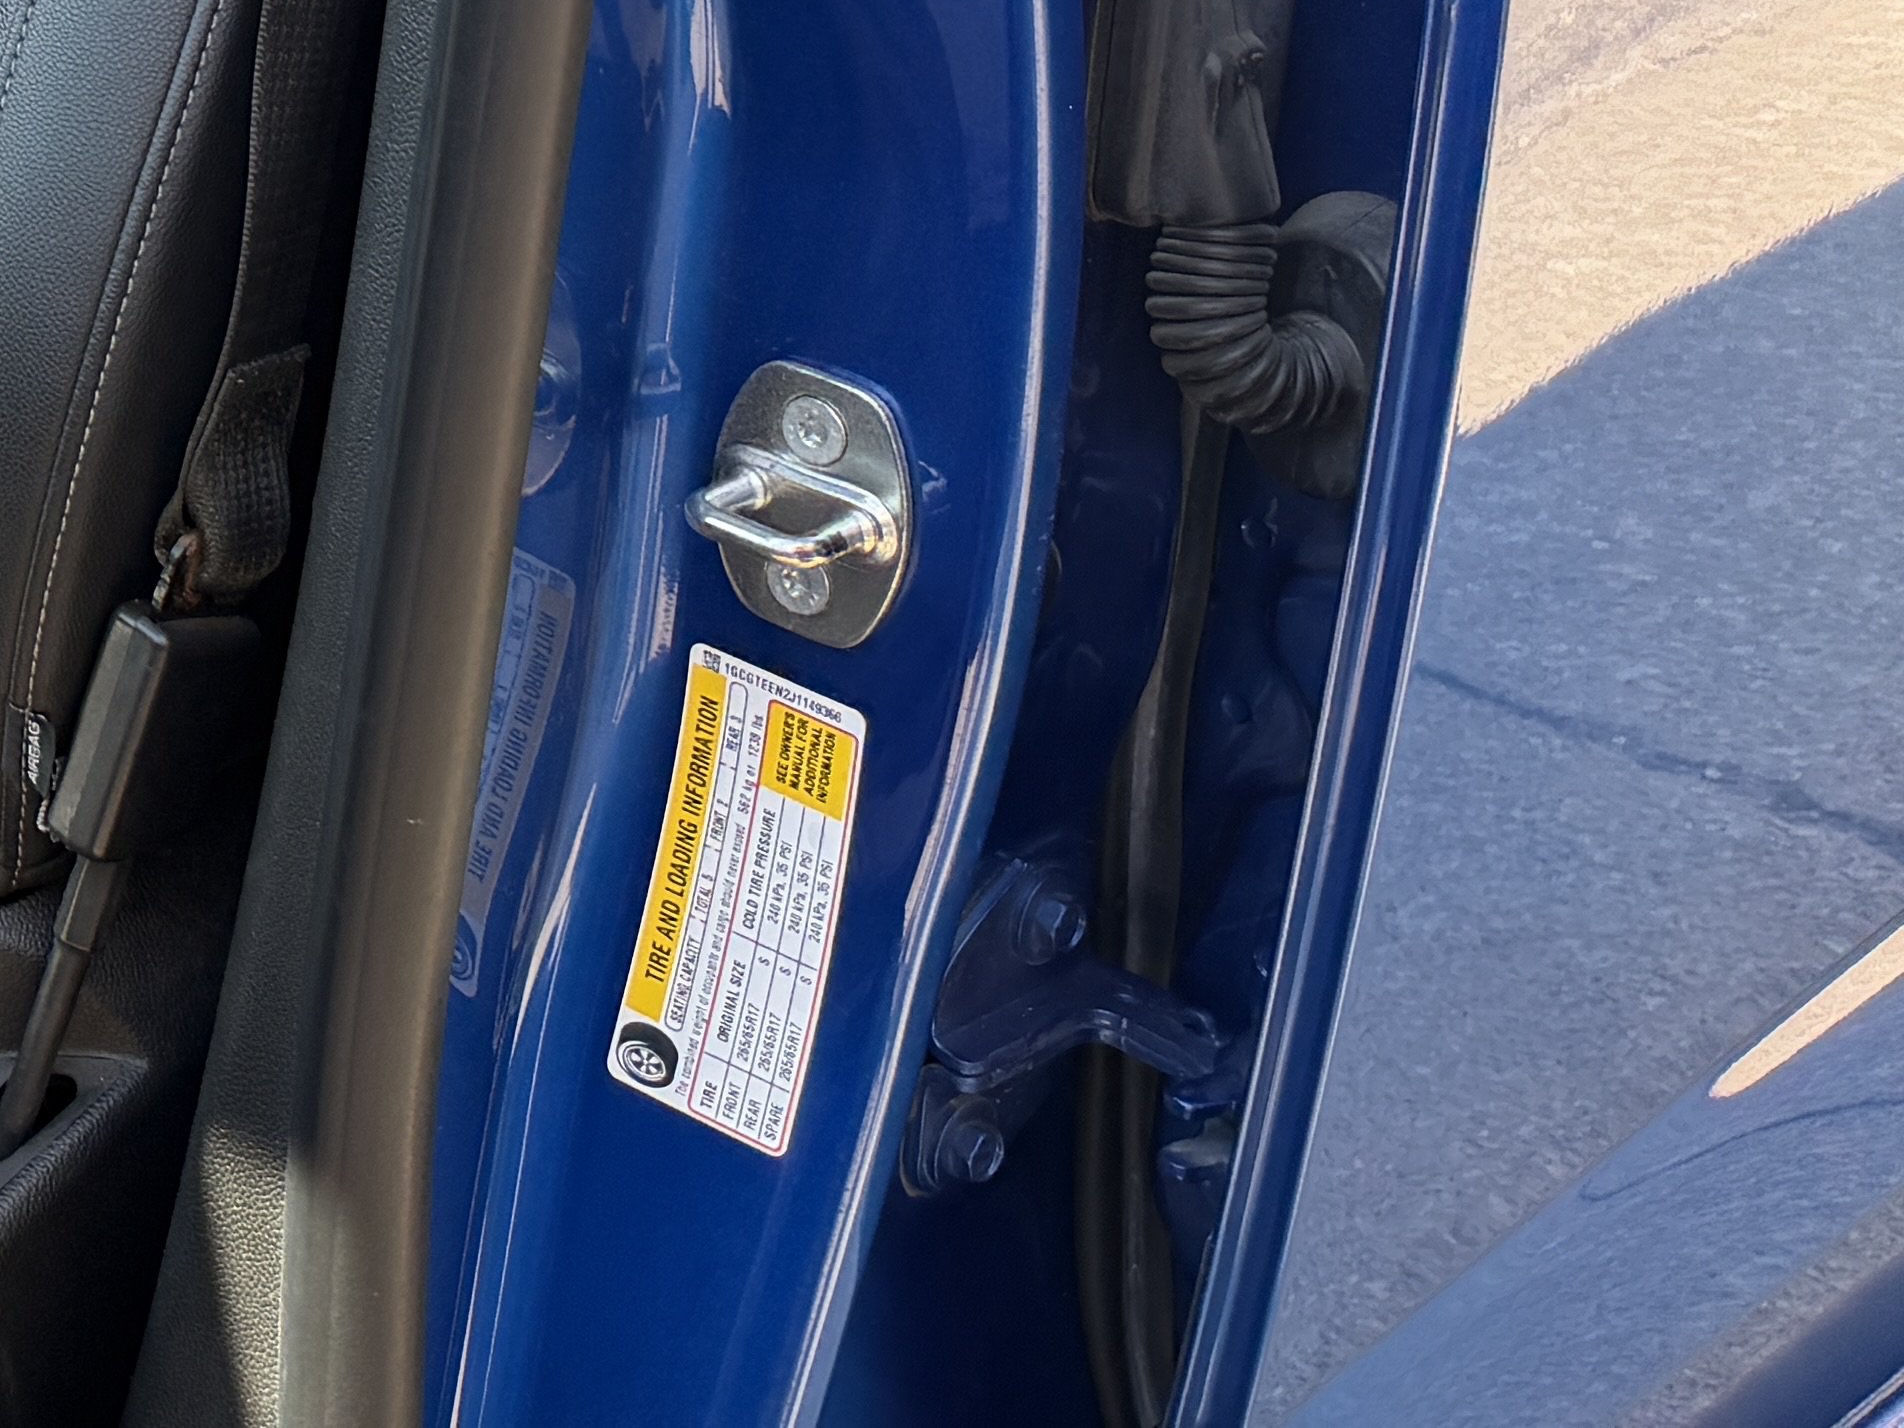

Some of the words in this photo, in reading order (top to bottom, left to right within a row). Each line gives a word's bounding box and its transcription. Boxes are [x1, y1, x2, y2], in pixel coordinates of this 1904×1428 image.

[729, 715, 742, 724] 3
[795, 718, 809, 743] FOR
[725, 726, 740, 752] REAR
[779, 712, 795, 761] OWNER'S
[27, 720, 40, 785] AIRBAG
[683, 696, 718, 816] INFORMATION
[804, 728, 823, 797] ADDITIONAL
[776, 761, 789, 784] SEE
[789, 745, 805, 790] MANUAL
[816, 732, 836, 803] INFORMATION
[737, 793, 751, 815] 562
[710, 810, 725, 842] FRONT
[754, 808, 776, 869] PRESSURE
[666, 819, 698, 897] LOADING
[779, 840, 792, 860] PSI
[799, 850, 813, 870] PSI
[701, 873, 713, 882] 5
[775, 862, 788, 877] 35
[796, 871, 809, 887] 35
[819, 859, 833, 879] PSI
[748, 870, 764, 897] TIRE
[816, 881, 830, 896] 35
[694, 886, 710, 914] TOTAL
[767, 903, 781, 925] 240
[656, 899, 680, 941] AND
[742, 899, 759, 930] COLD
[787, 912, 802, 934] 240
[808, 922, 823, 944] 240
[645, 941, 671, 982] TIRE
[679, 936, 699, 982] CAPACITY
[758, 956, 770, 967] S
[779, 966, 791, 976] S
[729, 960, 746, 988] SIZE
[799, 975, 812, 986] S
[670, 983, 690, 1025] SEATING
[717, 990, 740, 1043] ORIGINAL
[736, 1003, 759, 1062] 265/65R17
[757, 1012, 781, 1072] 265/65R17
[778, 1022, 802, 1082] 265/65R17
[700, 1081, 717, 1109] TIRE
[722, 1081, 741, 1120] FRONT
[743, 1099, 761, 1130] REAR
[764, 1102, 784, 1141] SPARE
